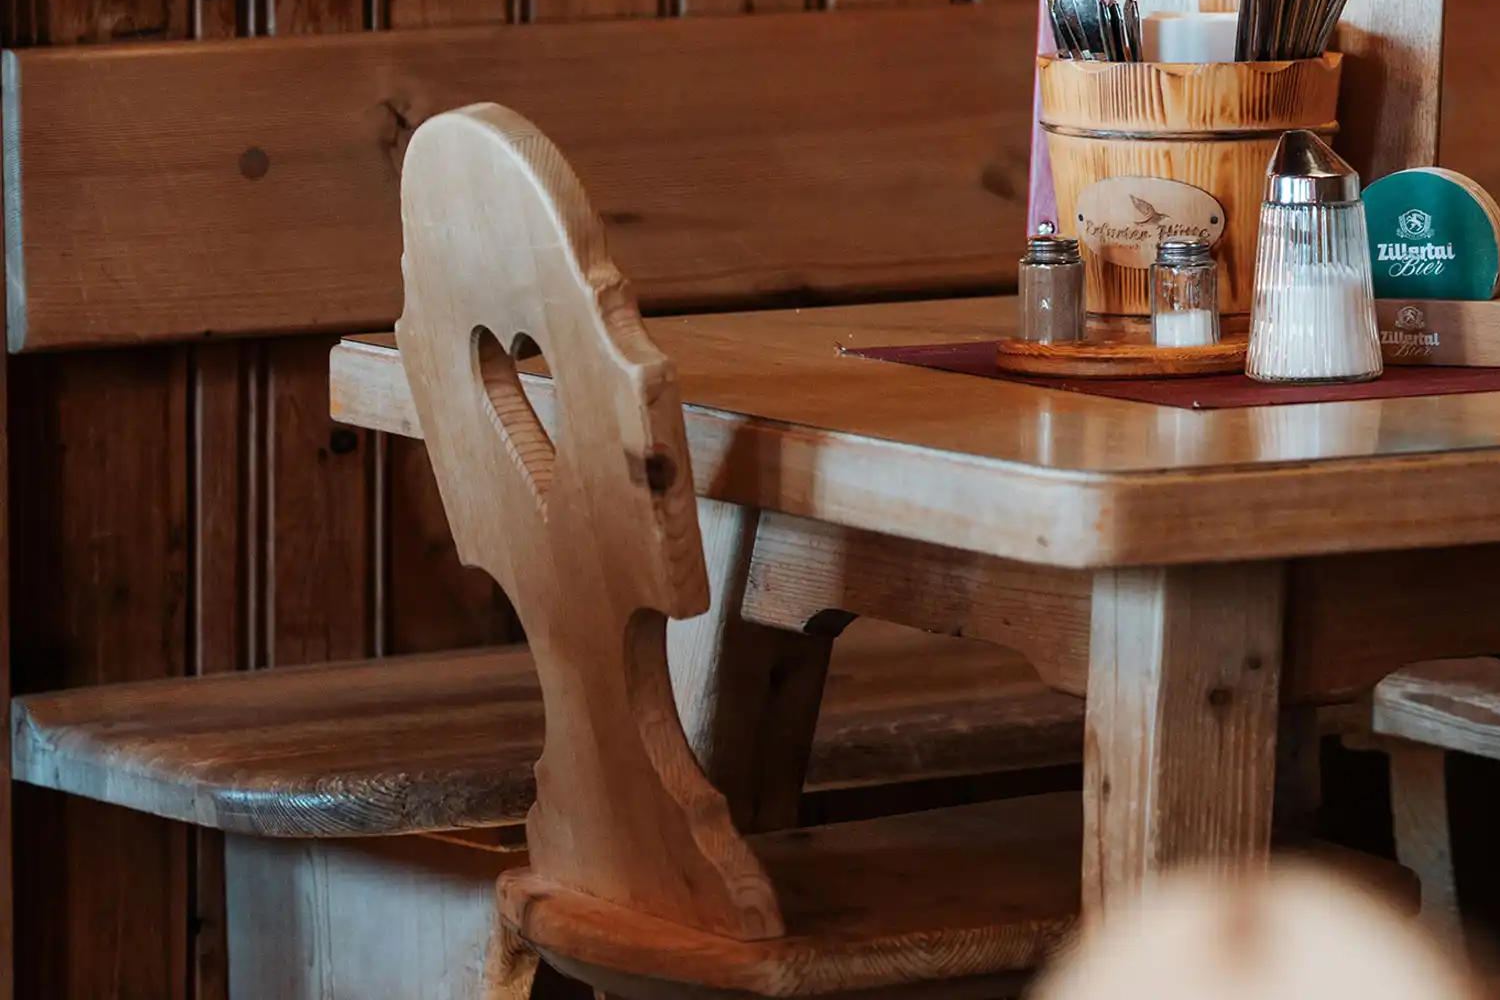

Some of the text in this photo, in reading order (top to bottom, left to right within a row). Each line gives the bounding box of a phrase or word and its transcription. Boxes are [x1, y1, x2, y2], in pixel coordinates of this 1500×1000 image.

[1377, 242, 1456, 261] Zillertal
[1388, 253, 1445, 277] Bier
[1381, 331, 1440, 346] Zillertal
